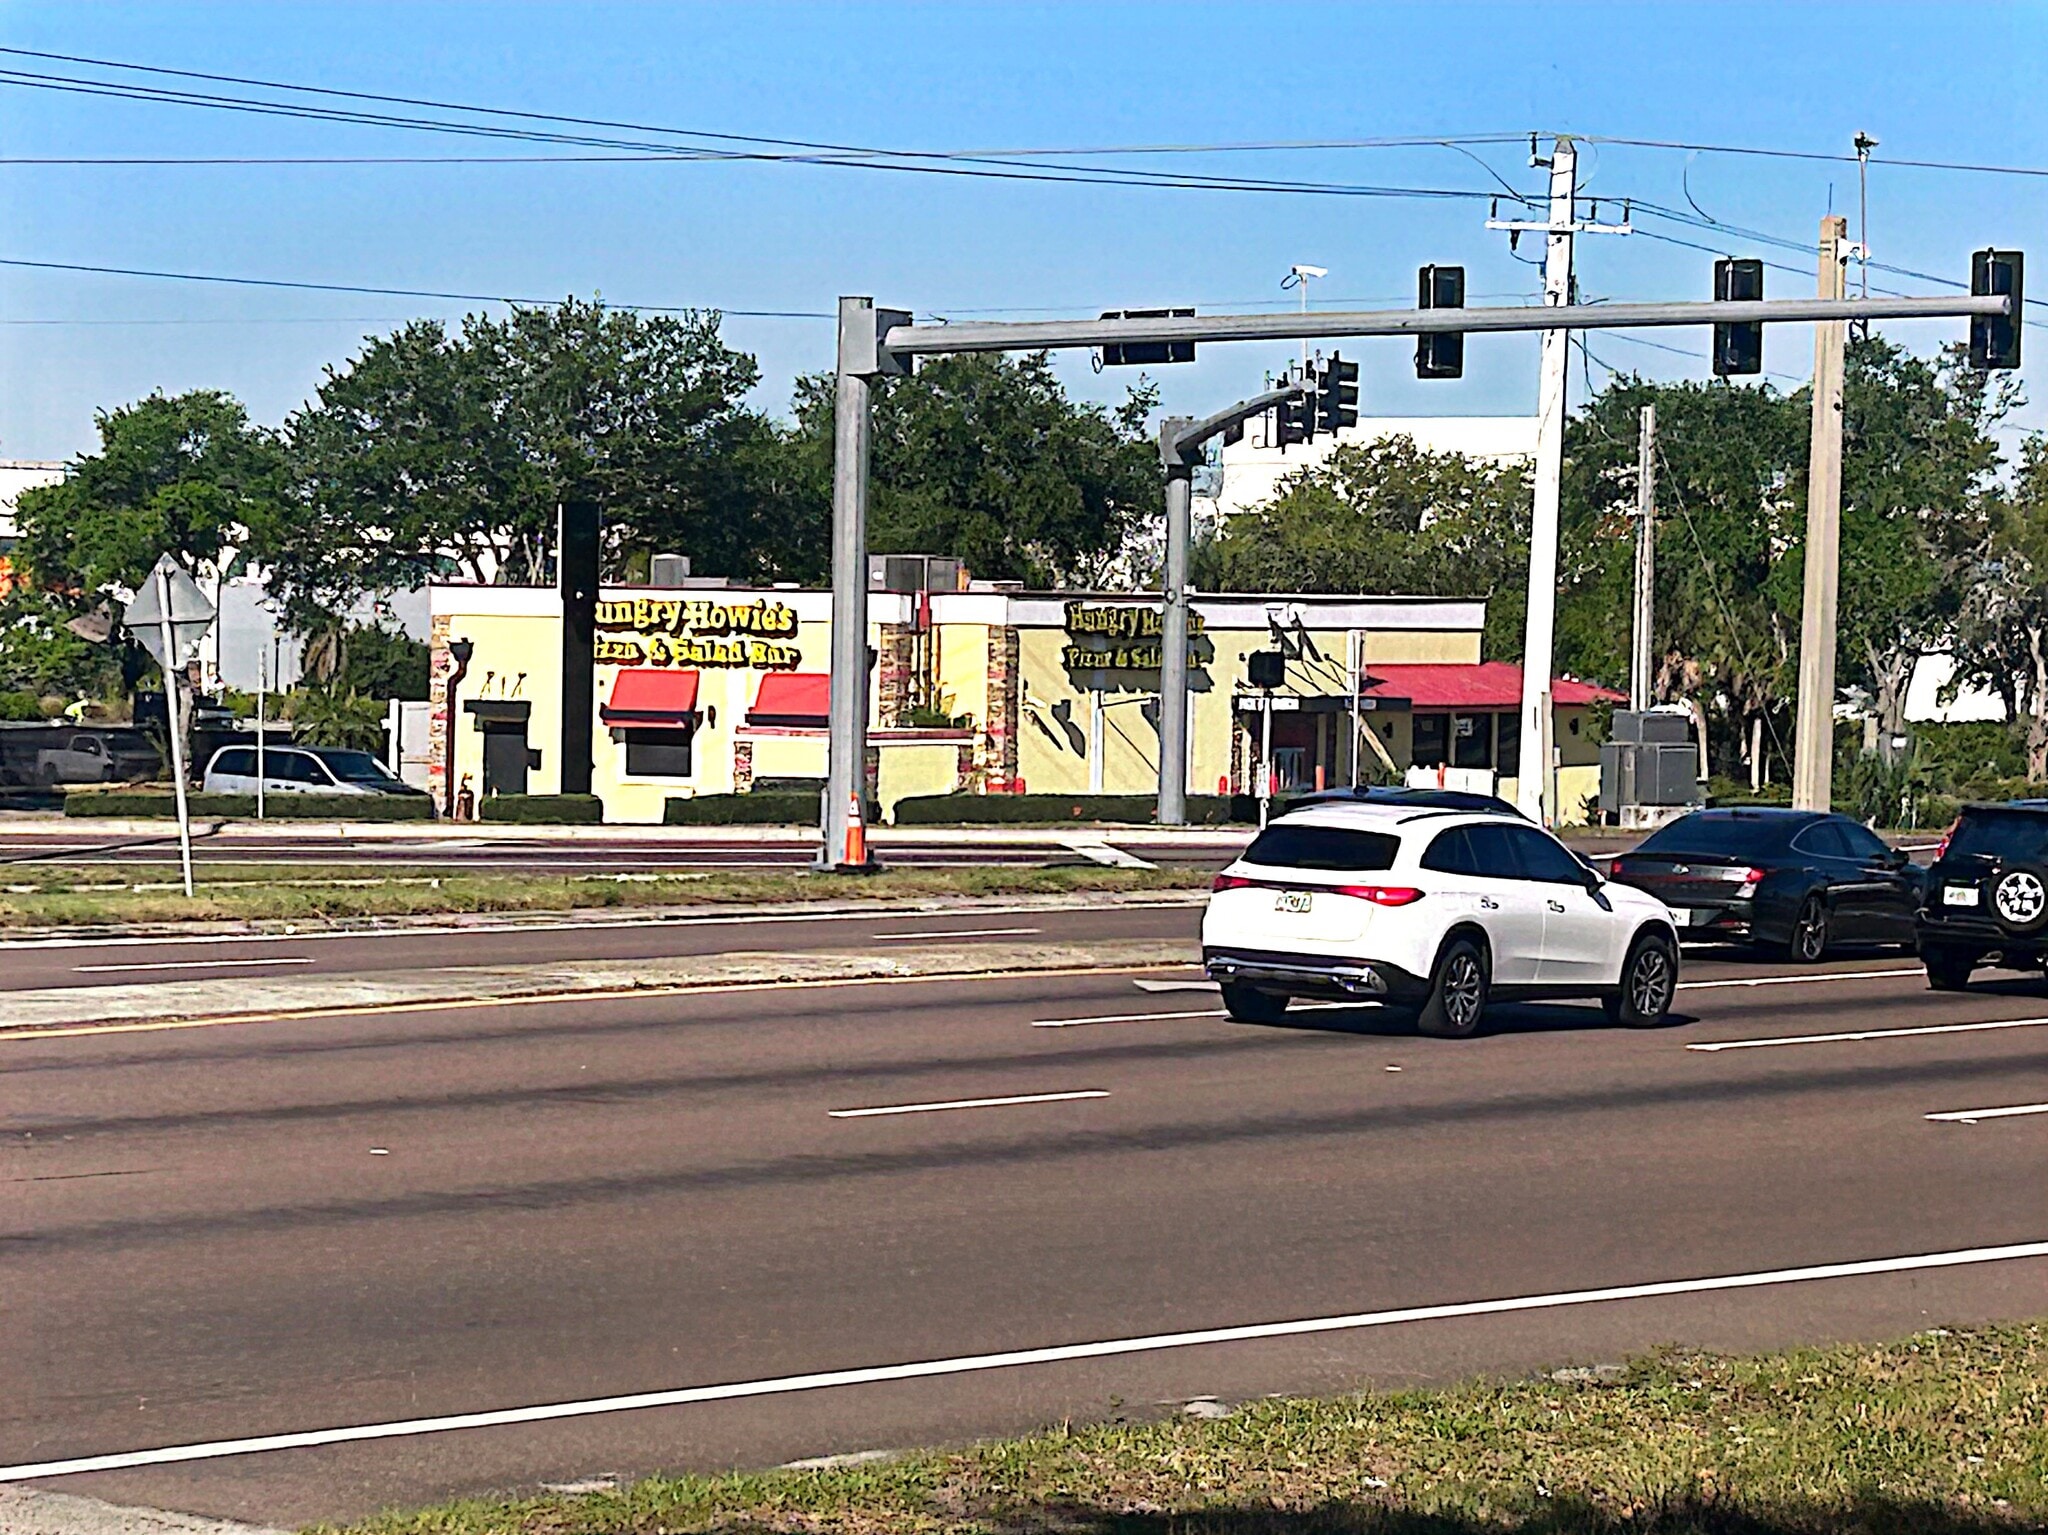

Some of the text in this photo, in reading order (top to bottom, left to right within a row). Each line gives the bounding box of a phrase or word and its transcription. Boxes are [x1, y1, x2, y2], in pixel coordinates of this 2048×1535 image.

[594, 599, 796, 635] ungry Howie's
[1070, 603, 1139, 637] Hungry
[594, 637, 641, 660] izza
[672, 640, 745, 663] Salad
[750, 641, 799, 665] Bar
[1131, 646, 1163, 668] Sal
